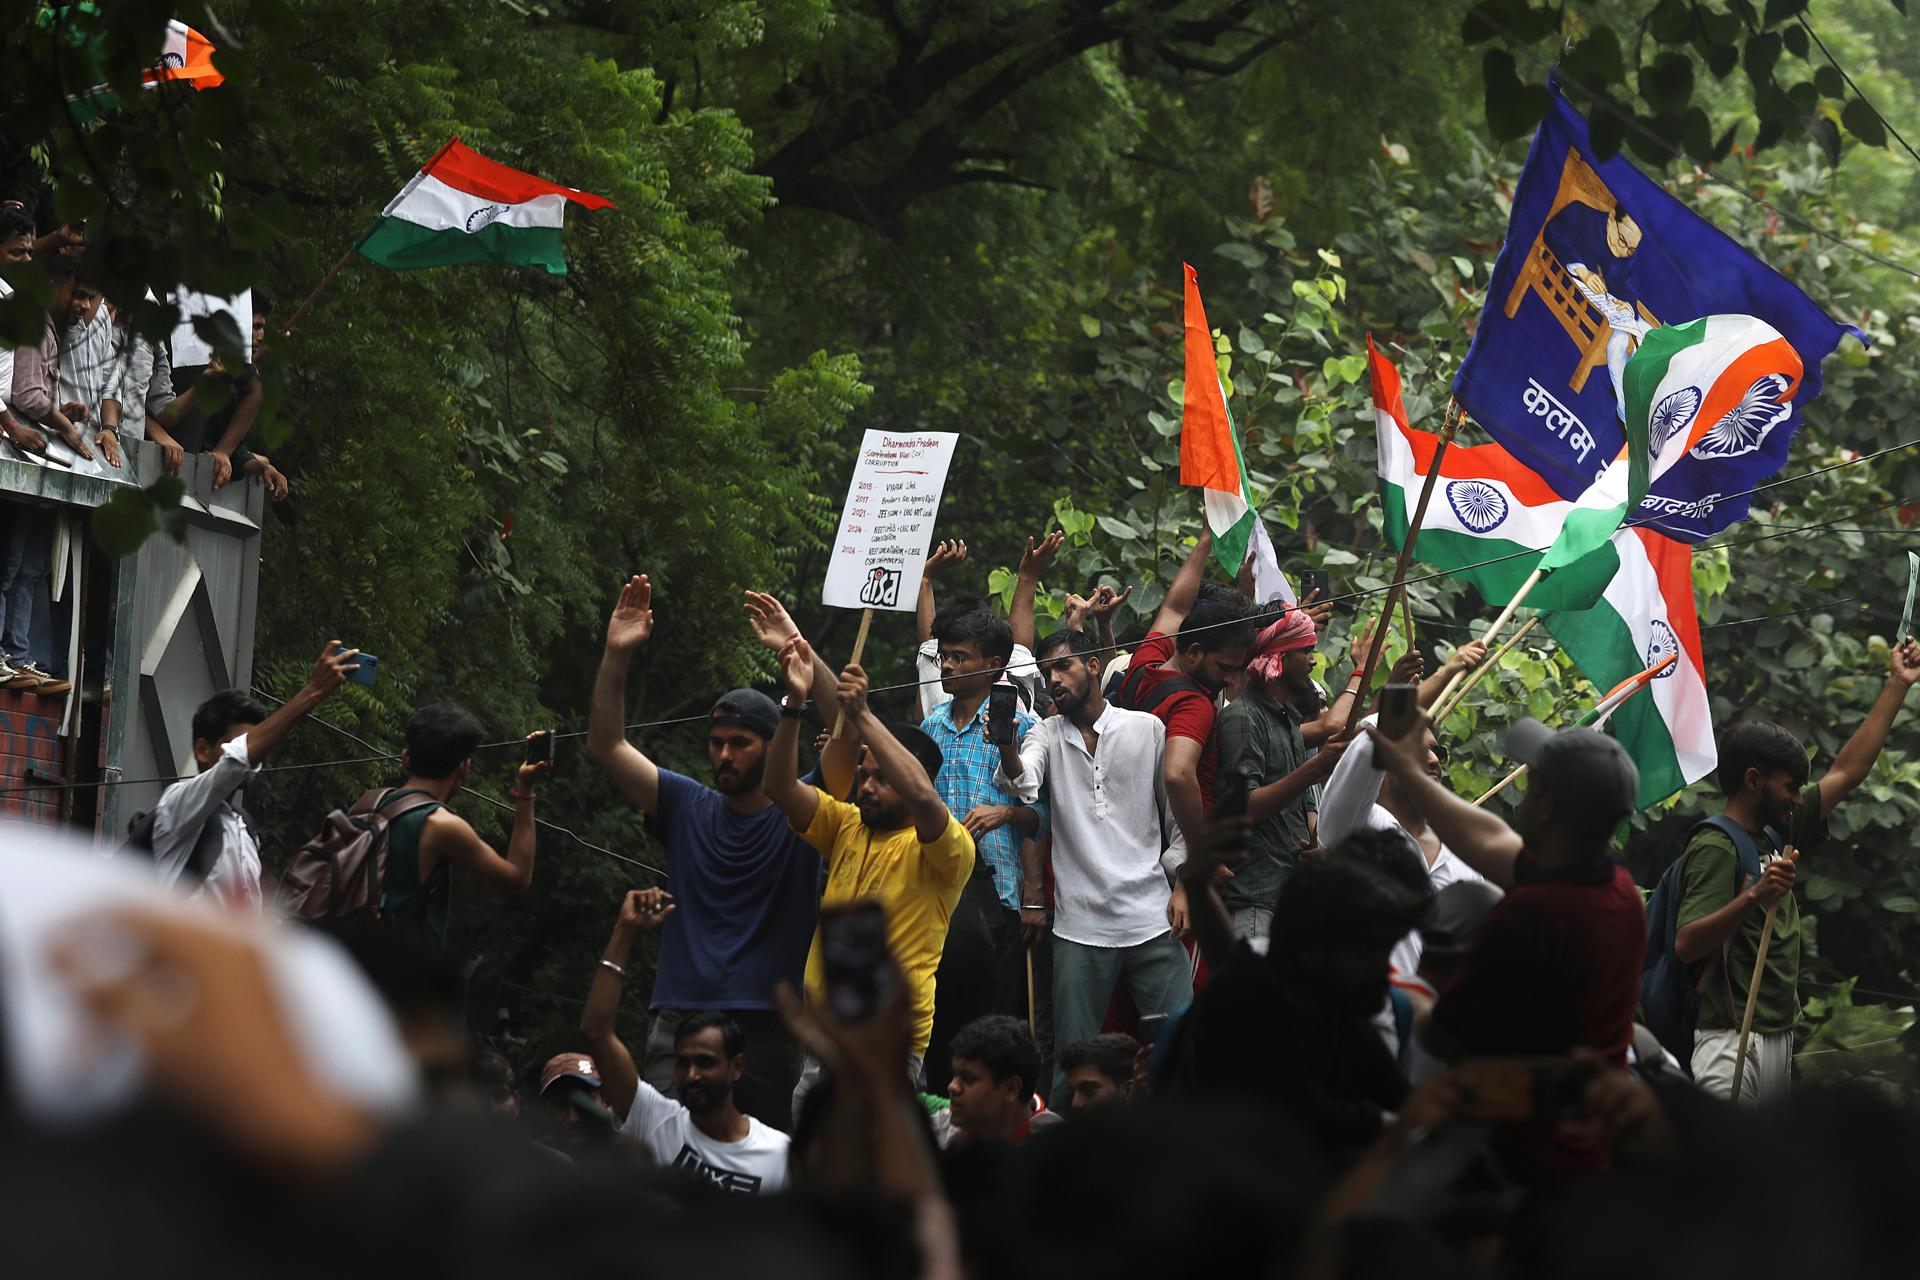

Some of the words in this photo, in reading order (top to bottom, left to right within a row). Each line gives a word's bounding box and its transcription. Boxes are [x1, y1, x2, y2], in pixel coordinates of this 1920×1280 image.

[1522, 377, 1596, 464] कलम
[864, 458, 899, 467] CORRUPTION
[851, 508, 866, 517] 2021
